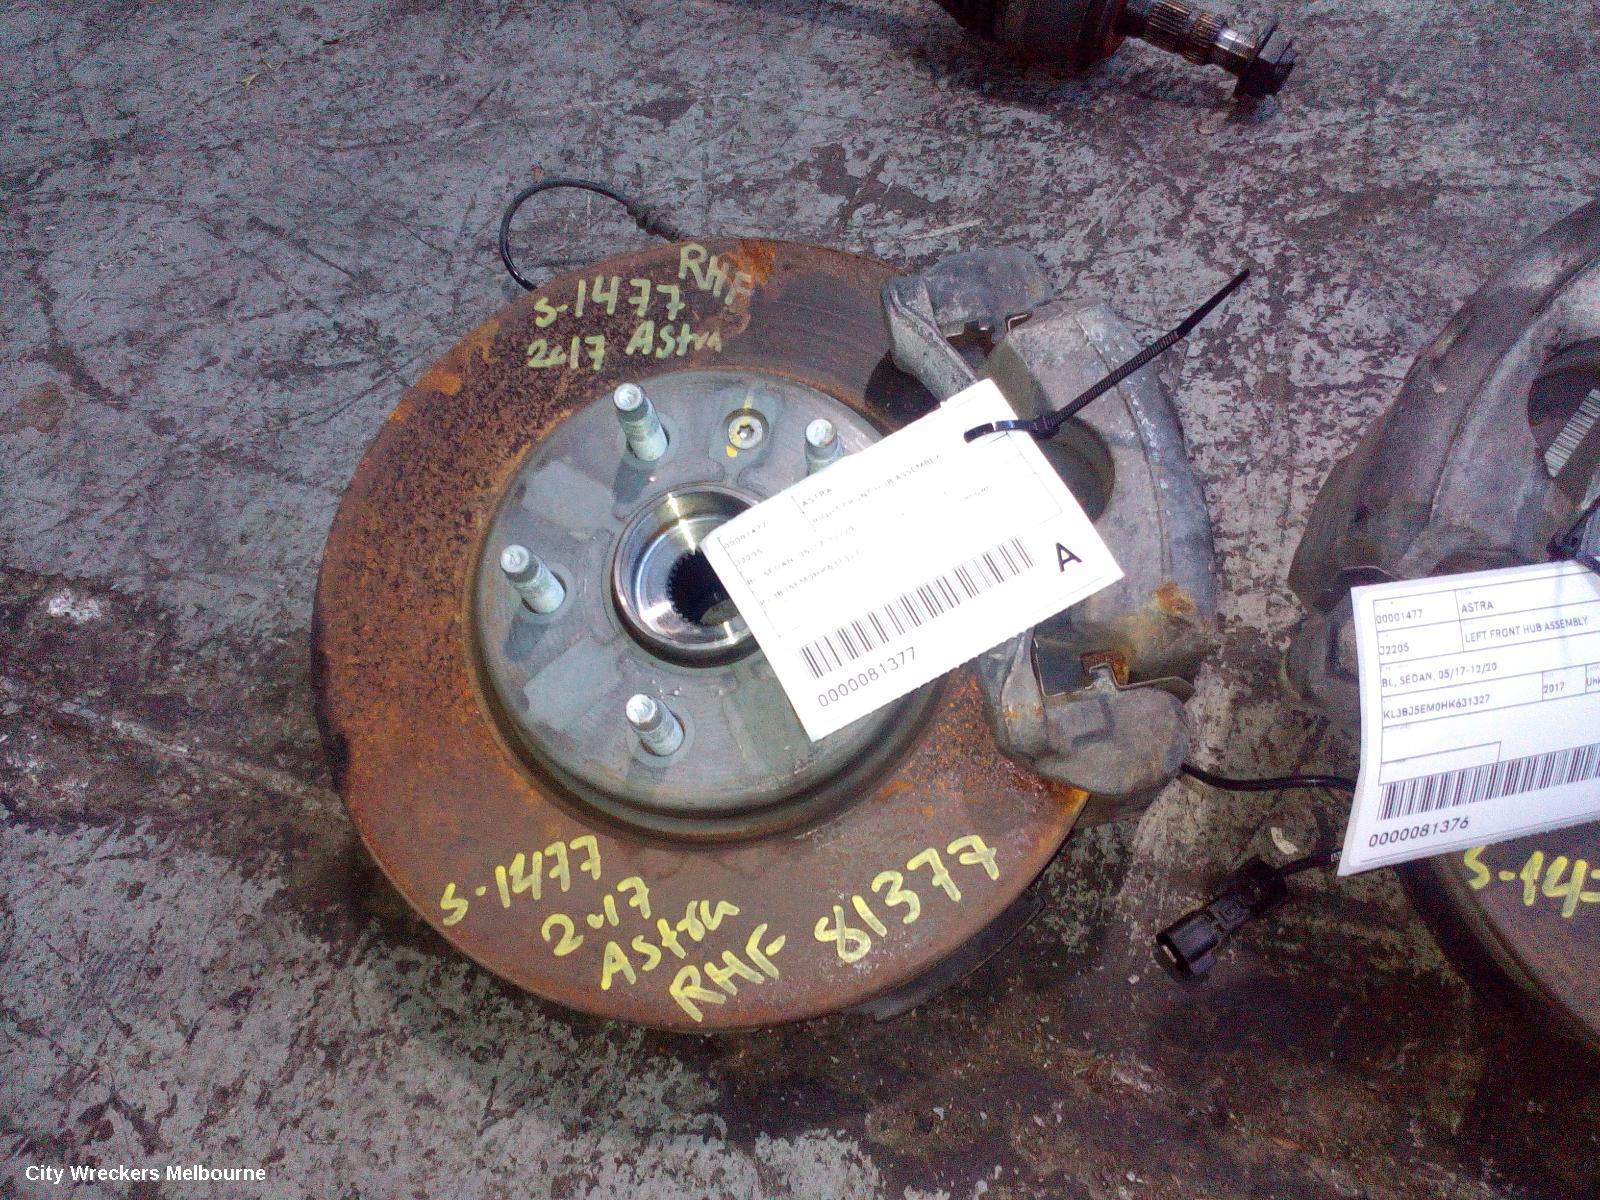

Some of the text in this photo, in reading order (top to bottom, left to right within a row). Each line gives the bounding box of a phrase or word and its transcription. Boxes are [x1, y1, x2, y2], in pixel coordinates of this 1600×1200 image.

[679, 243, 752, 305] RHF
[1054, 541, 1083, 573] A
[1376, 600, 1495, 625] 00001477 ASTRA
[1465, 616, 1589, 644] LEFT FRONT HUB ASSEMBLY
[816, 645, 918, 709] 0000081377
[1438, 662, 1498, 681] 05/17-12/20
[1543, 682, 1566, 695] 2017
[1369, 816, 1470, 848] 0000081376
[814, 833, 1001, 965] 81377
[669, 922, 787, 1022] RHF
